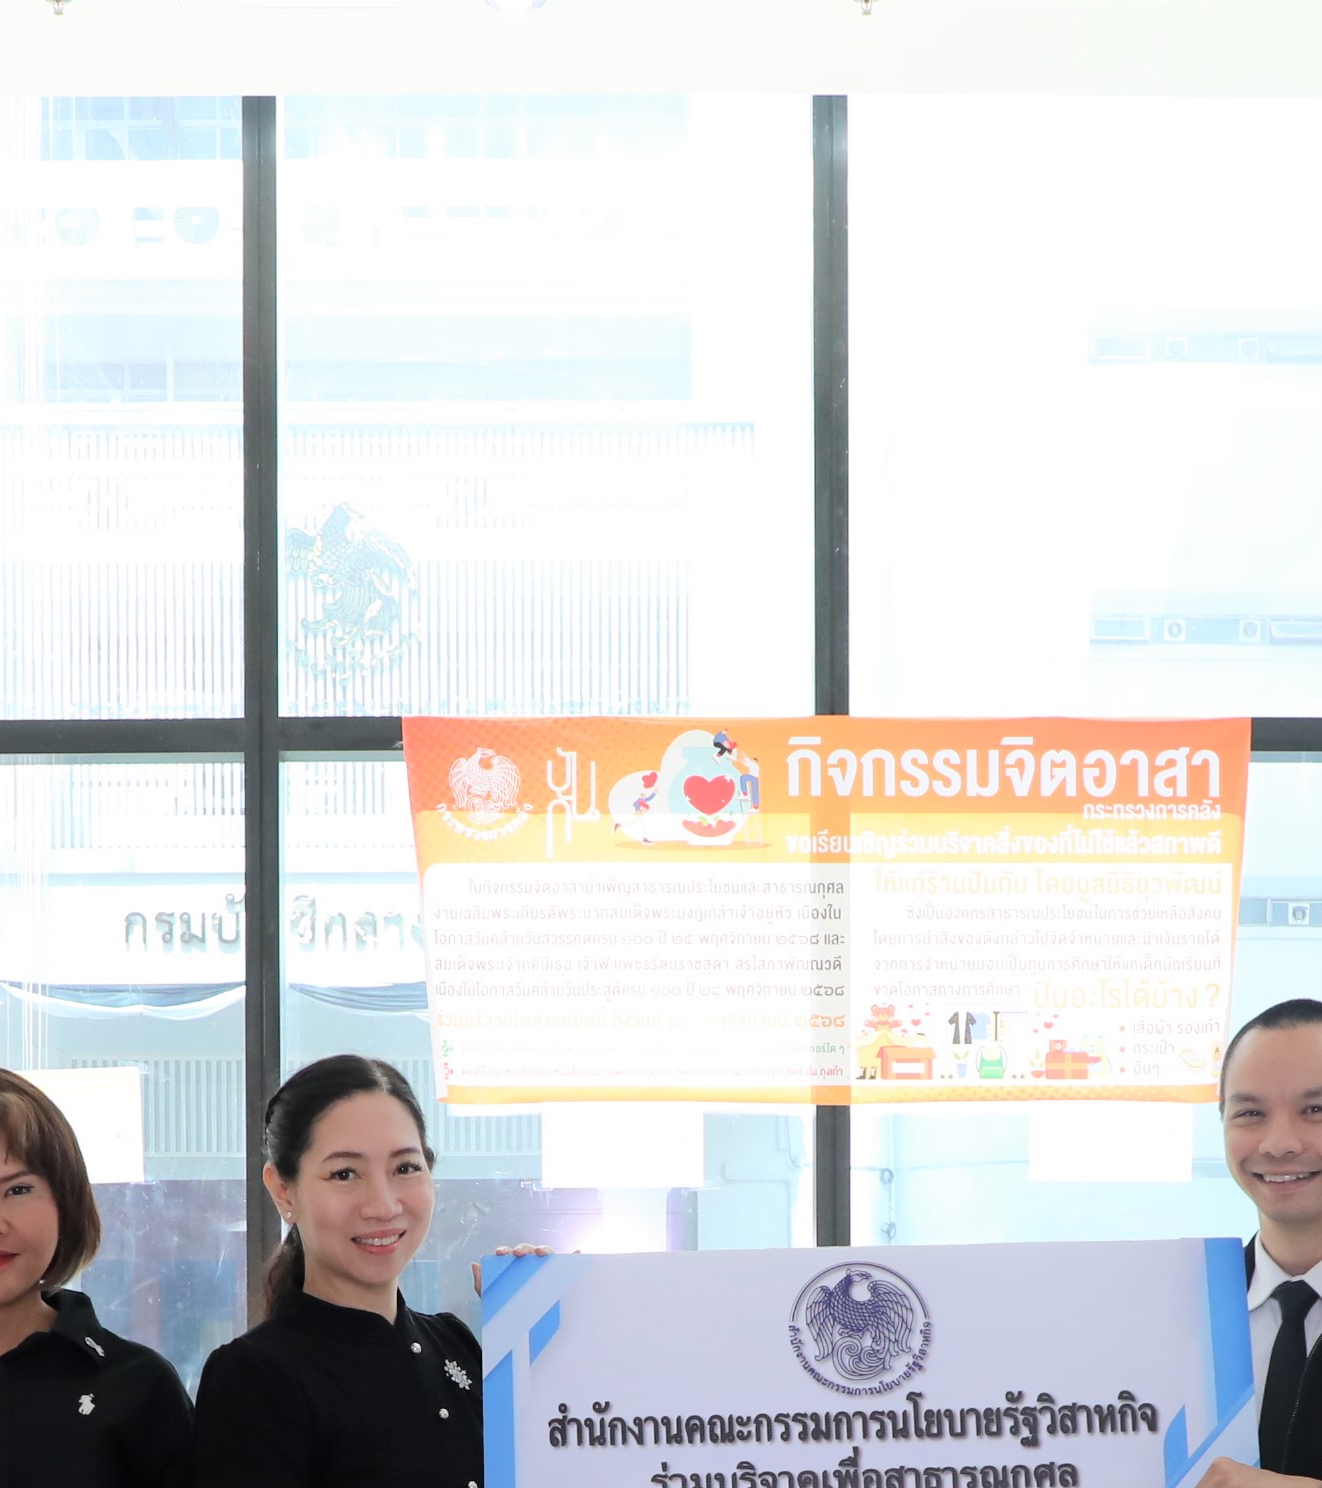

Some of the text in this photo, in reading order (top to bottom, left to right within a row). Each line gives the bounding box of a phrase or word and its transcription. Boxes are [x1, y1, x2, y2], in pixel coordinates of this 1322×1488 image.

[786, 736, 1221, 797] กิจกรรมจิตอาสา
[1082, 799, 1221, 821] กระทรวงการคลัง
[124, 892, 424, 951] กรมบัชีกลา
[824, 932, 845, 945] และ
[547, 1392, 1159, 1450] สำนักงานคณะกรรมการนโยบายรัฐวิสาหกิจ
